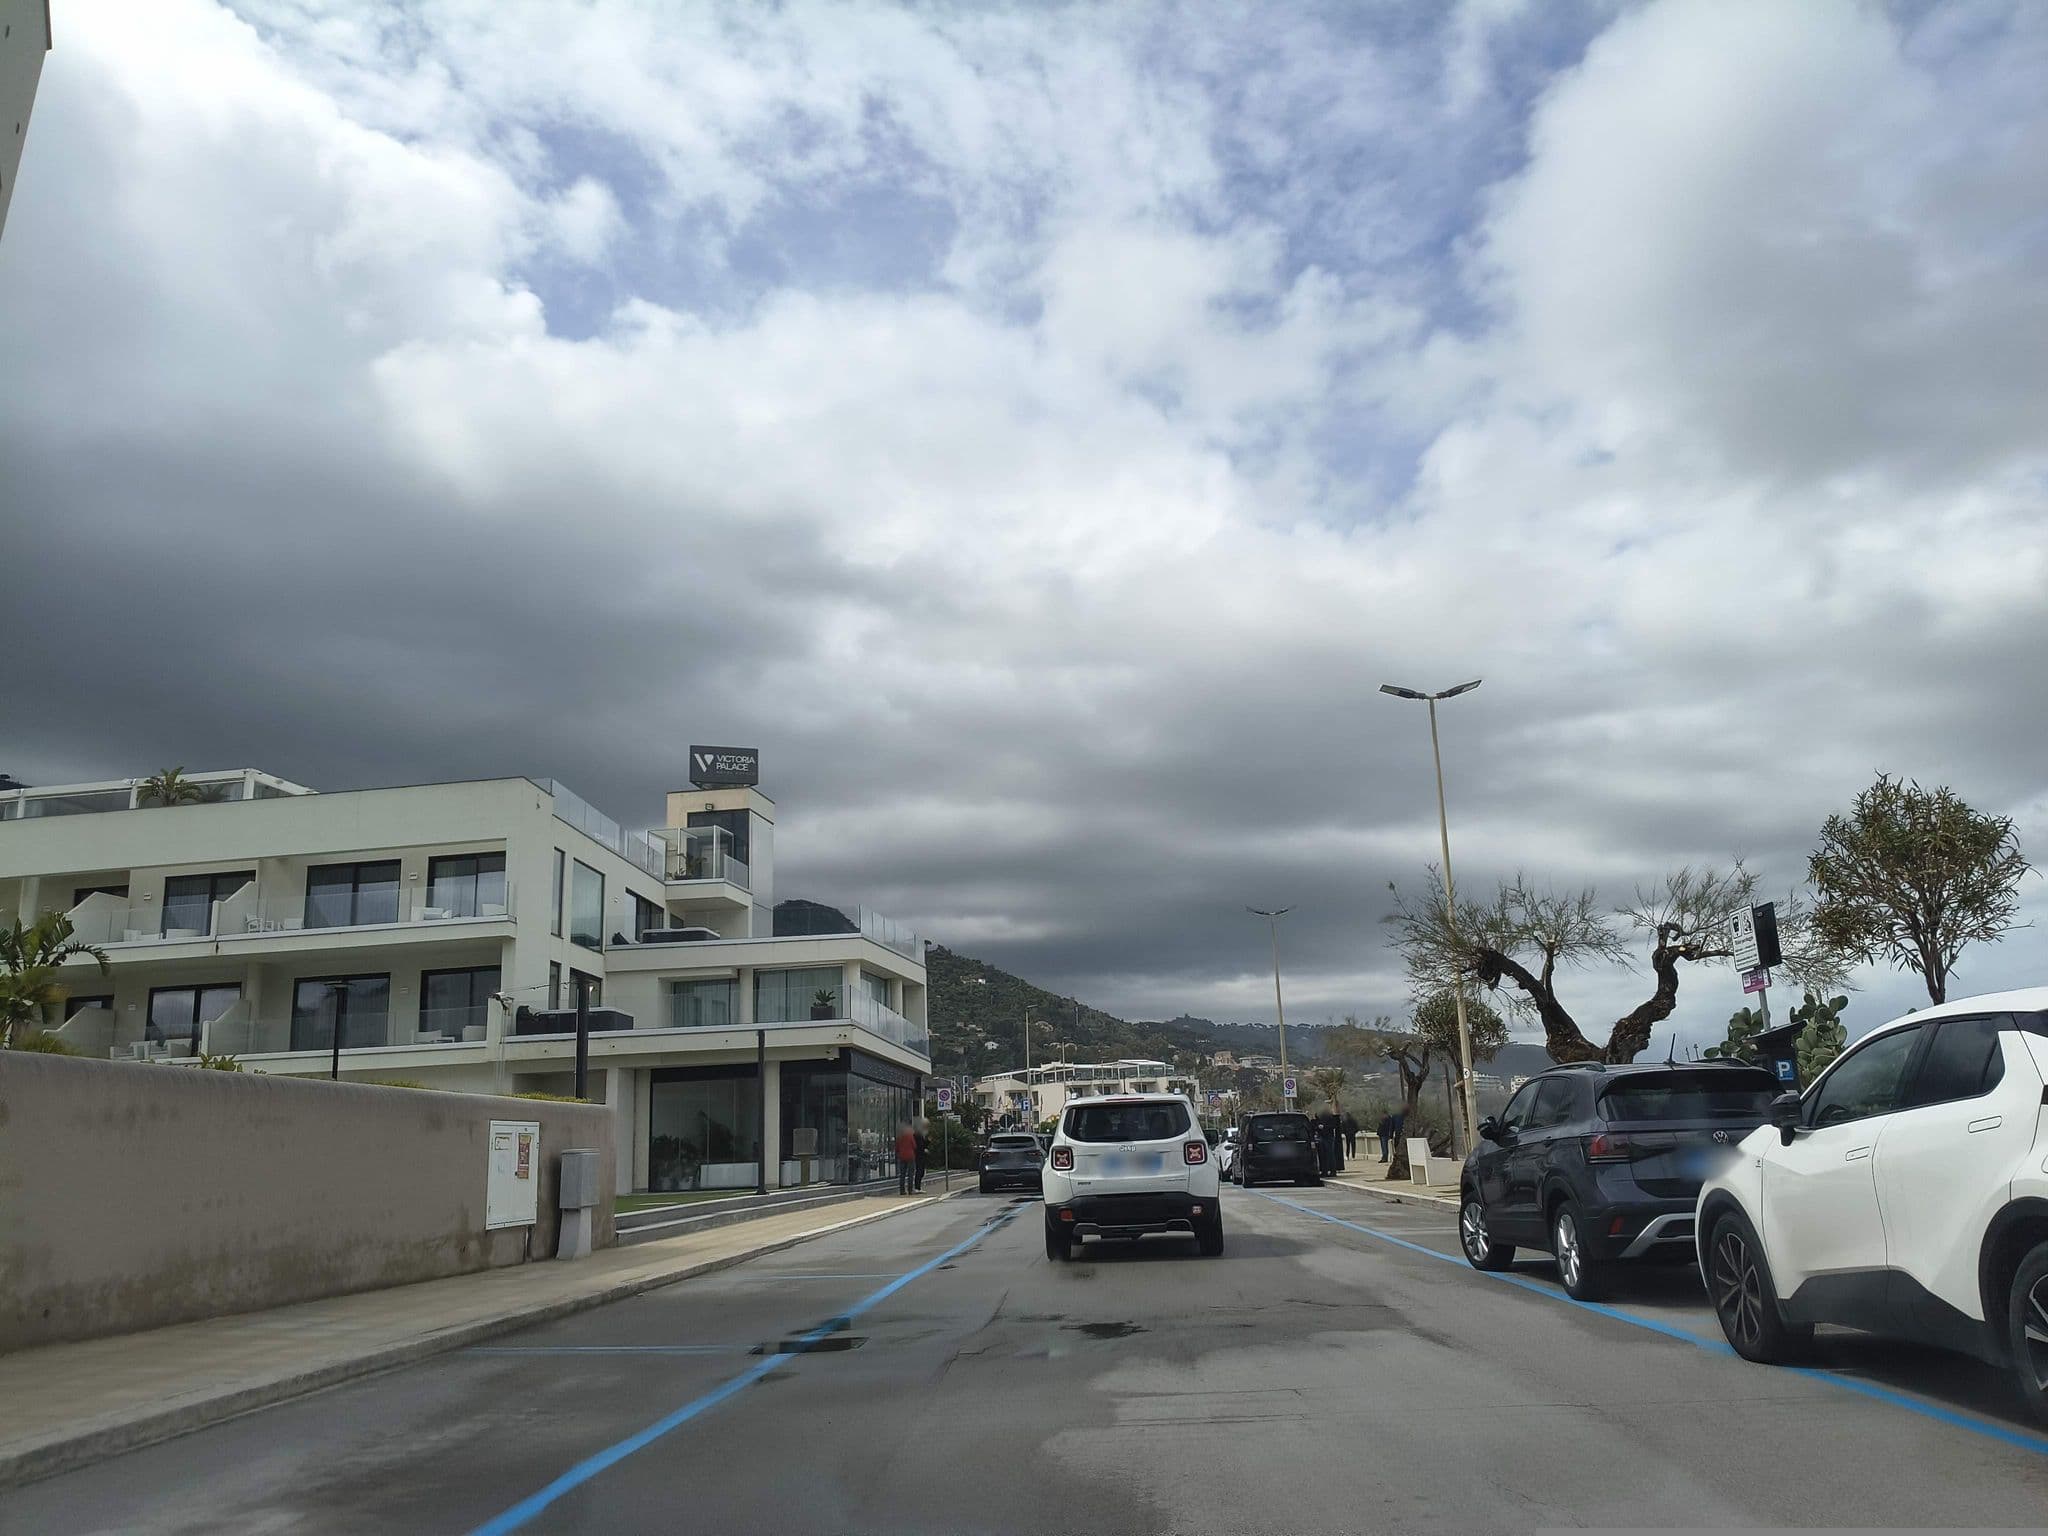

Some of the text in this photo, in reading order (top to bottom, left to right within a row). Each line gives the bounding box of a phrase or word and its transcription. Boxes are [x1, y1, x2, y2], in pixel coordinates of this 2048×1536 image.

[716, 754, 755, 764] VICTORIA
[716, 762, 749, 772] PALACE
[1777, 1061, 1790, 1077] P
